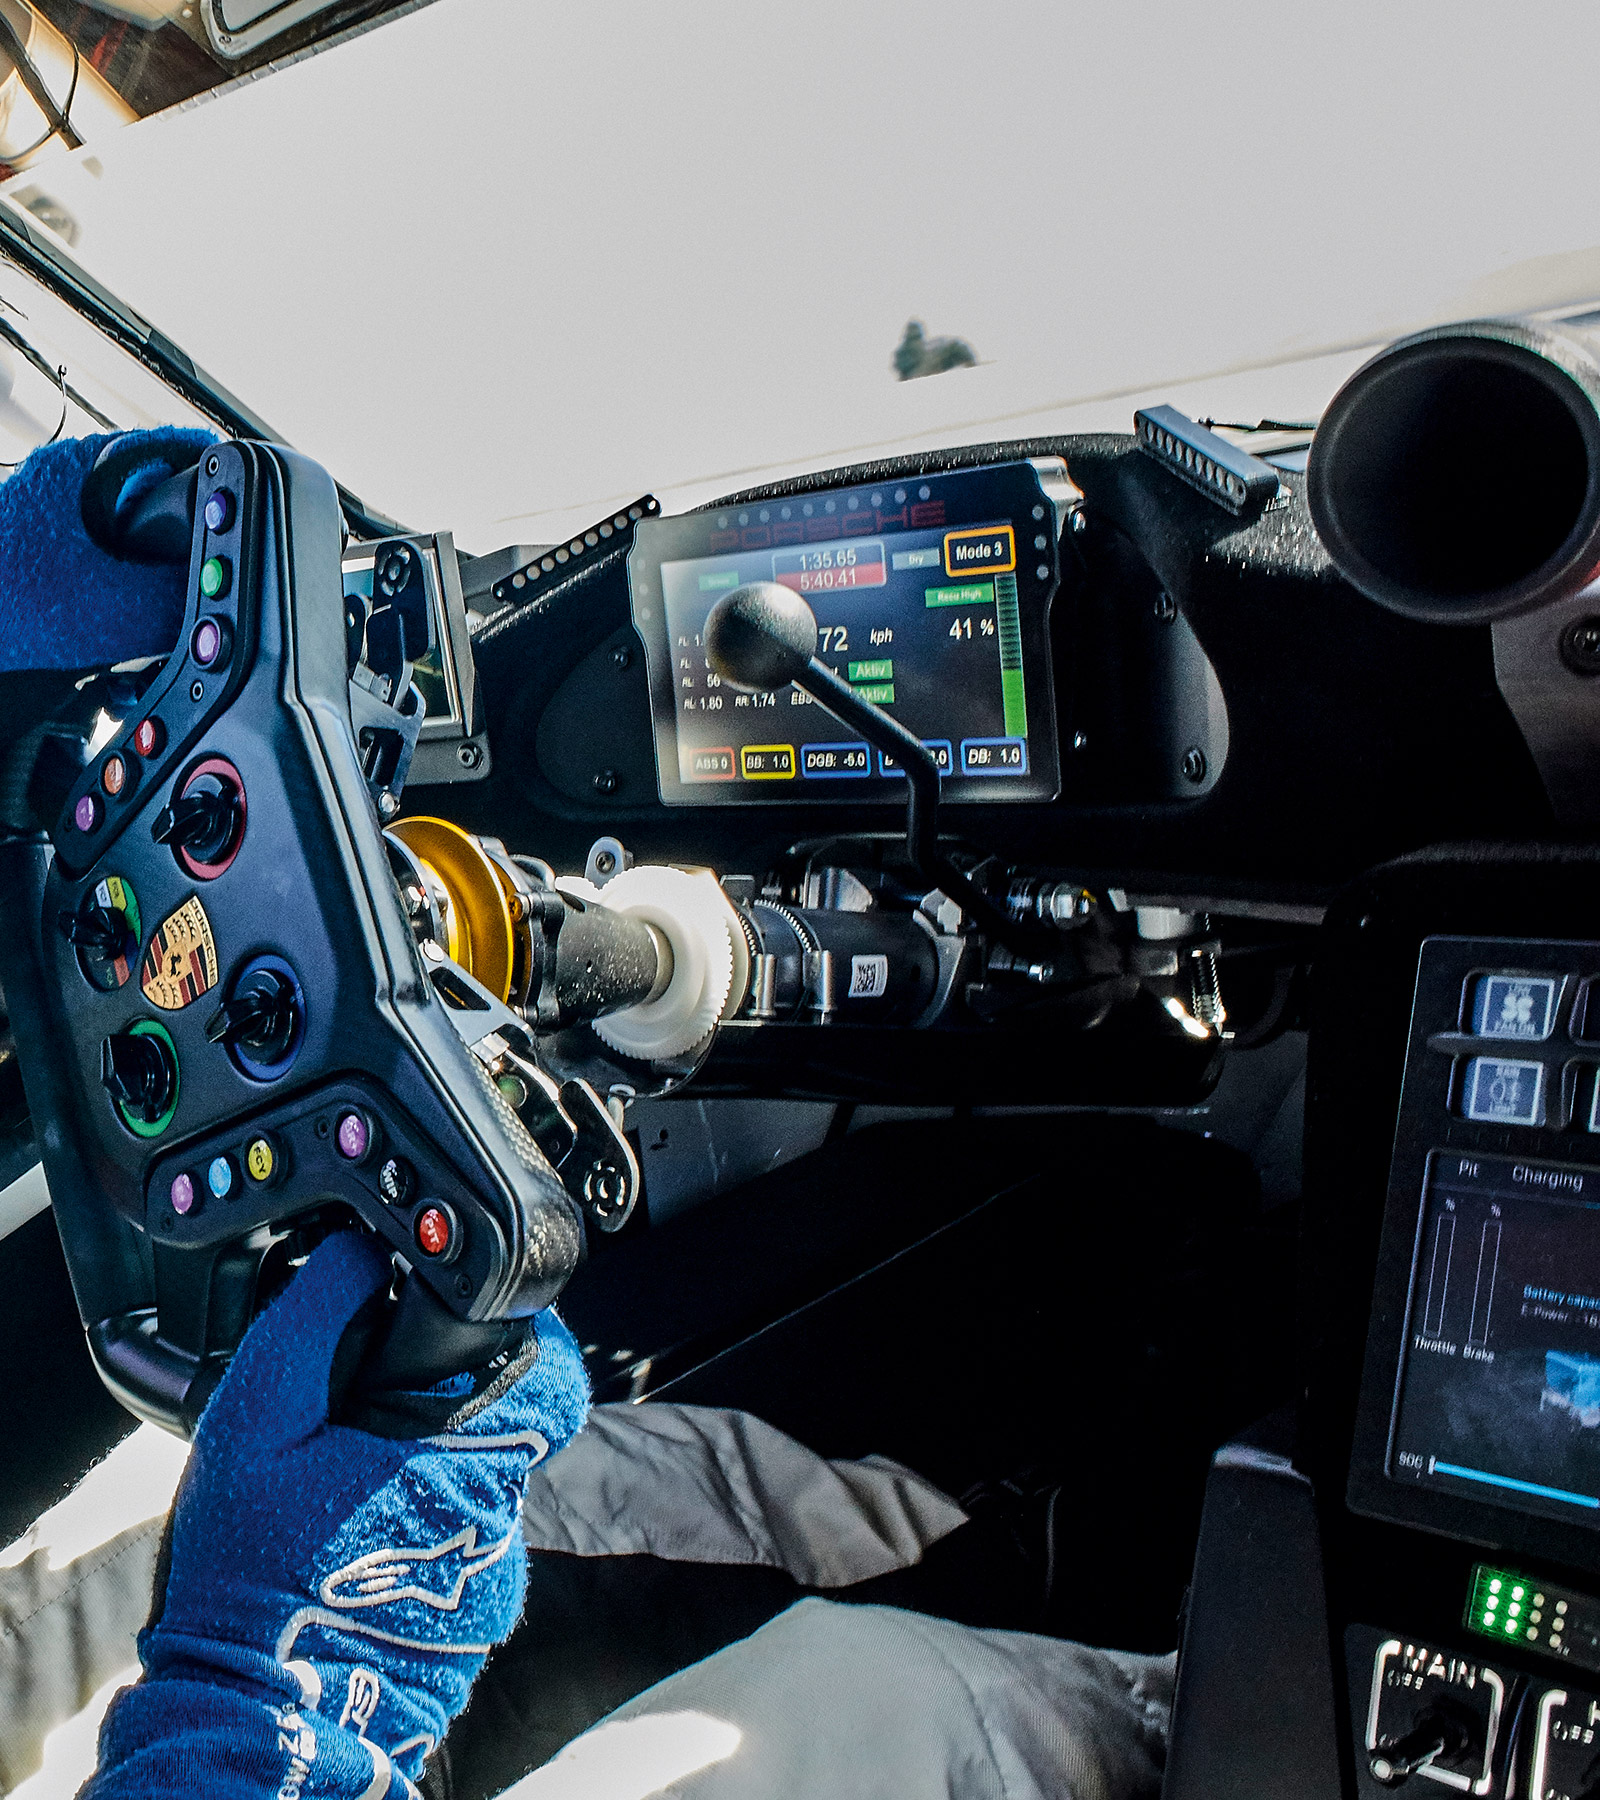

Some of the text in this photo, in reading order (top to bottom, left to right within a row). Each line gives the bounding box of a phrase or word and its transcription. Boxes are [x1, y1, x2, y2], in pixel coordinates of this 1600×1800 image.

[710, 500, 945, 552] PORSCHE
[956, 541, 1003, 561] Mode 3
[818, 625, 893, 653] 72 kph
[949, 617, 995, 640] 41 %
[855, 661, 886, 679] Aktiv
[751, 692, 776, 708] 1.74
[772, 754, 789, 769] 1.0
[1000, 747, 1020, 764] 1.0
[191, 899, 219, 986] PORSCHE
[253, 1146, 267, 1174] FCY
[382, 1166, 398, 1199] WIP
[1458, 1158, 1584, 1193] Pit Charging
[424, 1218, 440, 1244] PIT
[1414, 1334, 1457, 1356] Throttle
[1462, 1345, 1496, 1364] Brake
[1402, 1643, 1478, 1690] MAIN
